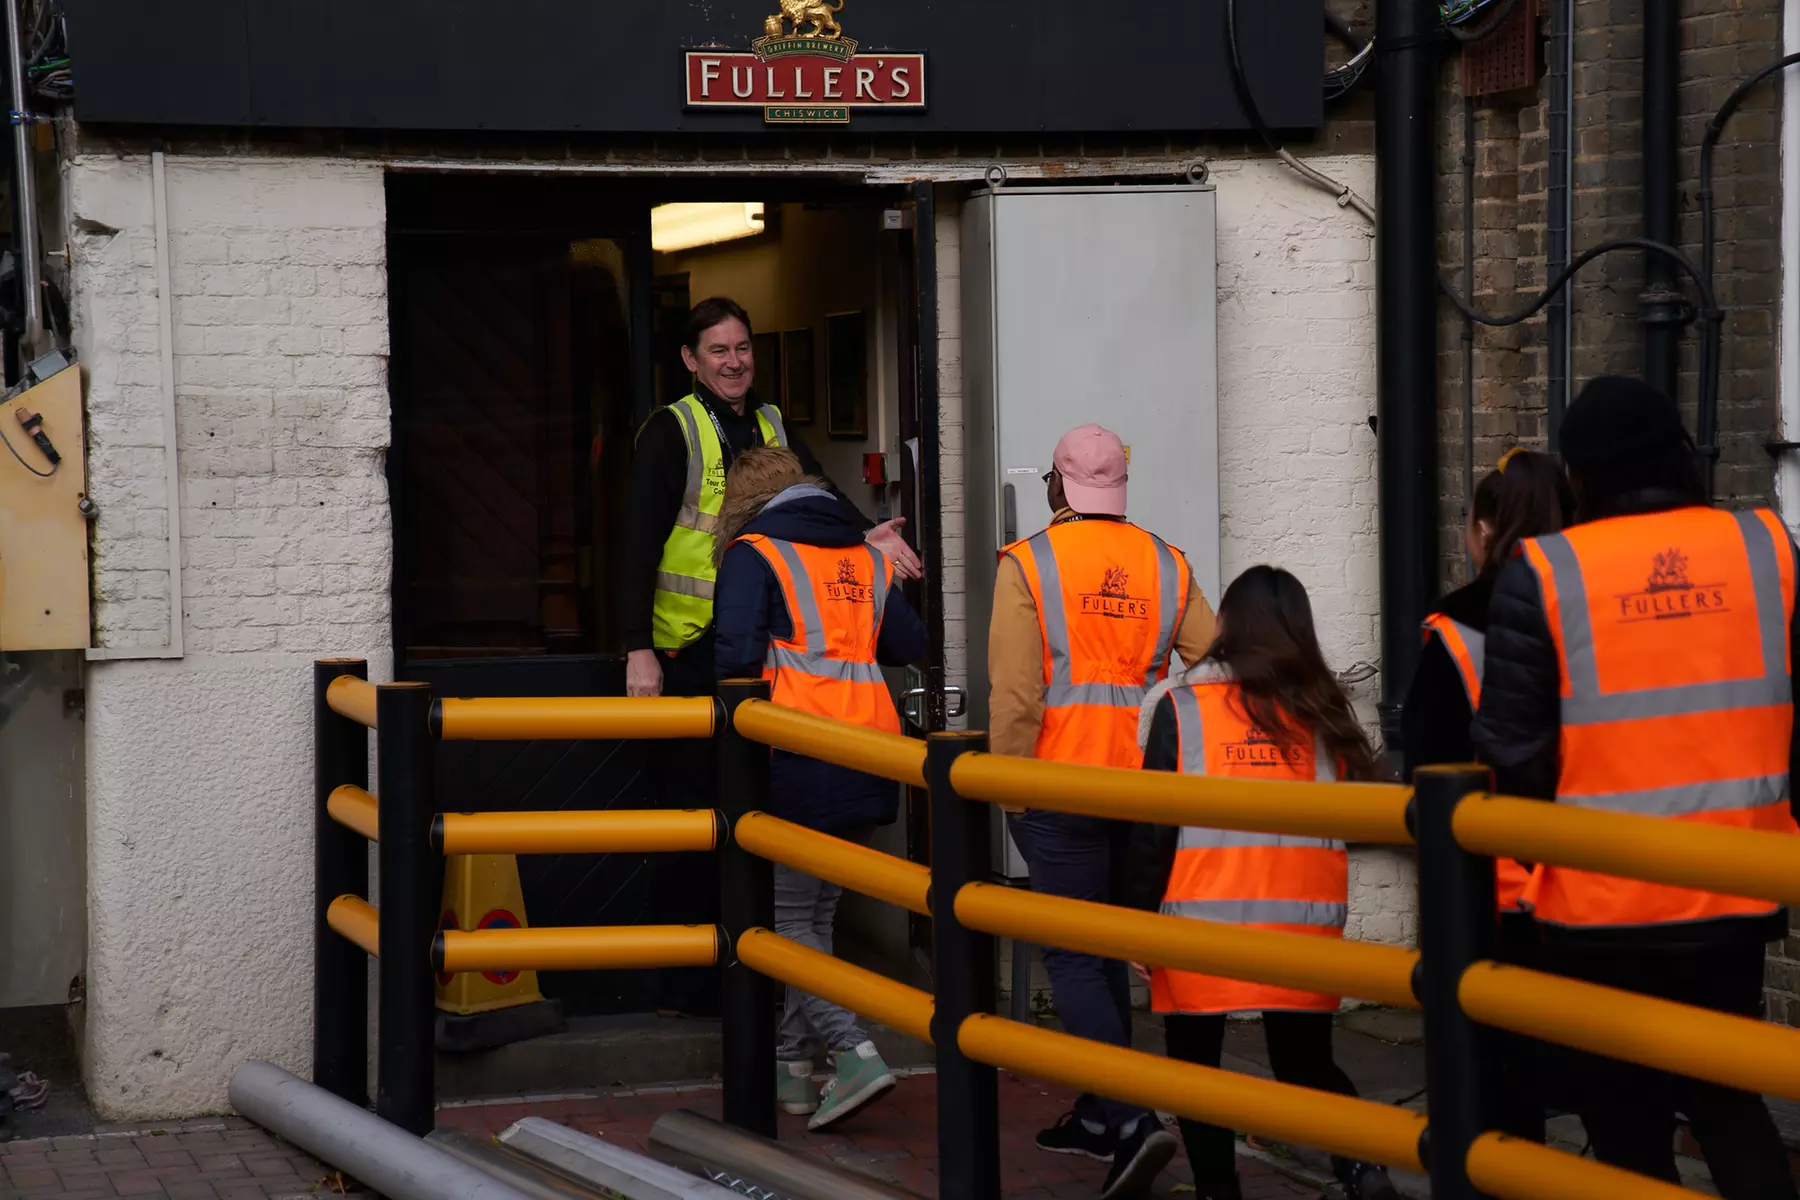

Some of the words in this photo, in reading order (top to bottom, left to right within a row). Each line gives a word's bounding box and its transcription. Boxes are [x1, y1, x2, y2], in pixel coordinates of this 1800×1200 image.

[767, 41, 802, 53] GRIFFIN
[806, 41, 845, 54] BREWERY
[699, 58, 911, 102] FULLER'S
[774, 109, 839, 118] CHISWICK
[706, 478, 719, 487] Tour
